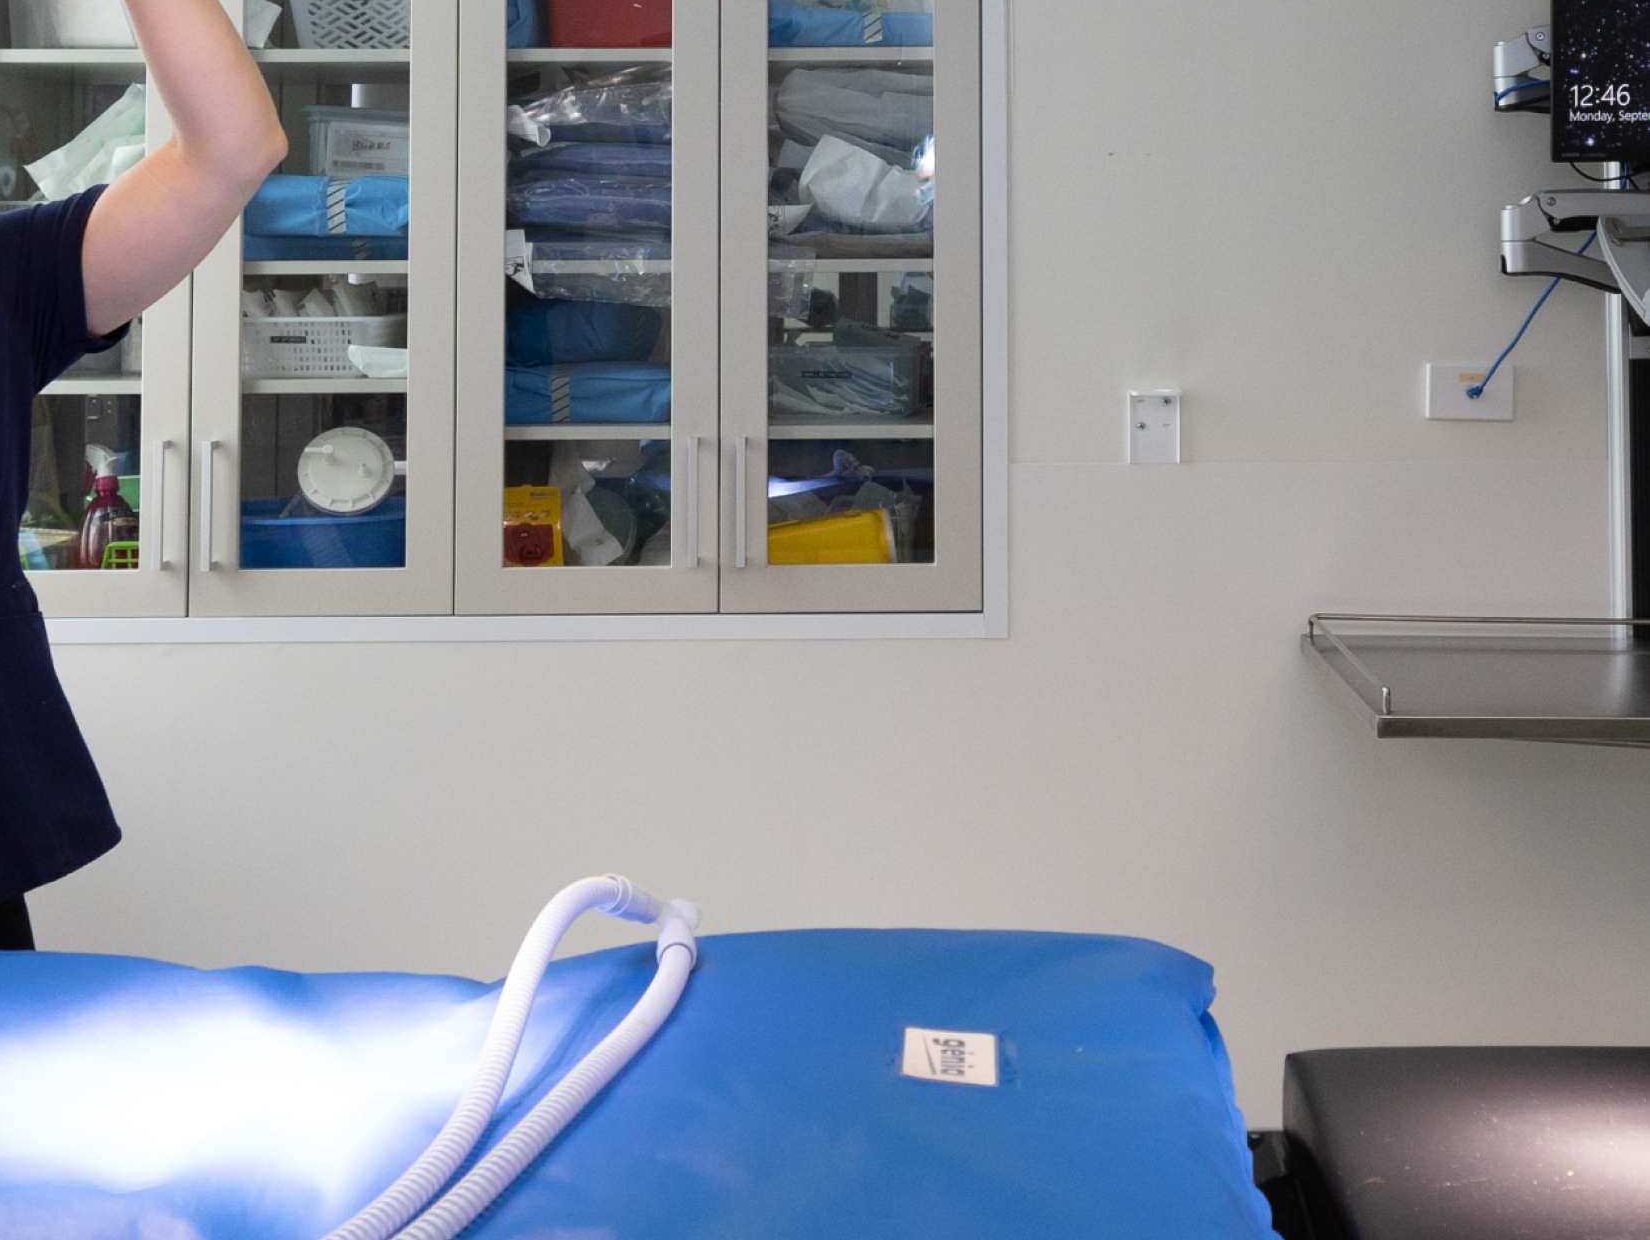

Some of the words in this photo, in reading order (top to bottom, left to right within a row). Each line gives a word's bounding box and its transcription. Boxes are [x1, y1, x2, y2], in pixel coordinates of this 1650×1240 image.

[1569, 83, 1631, 108] 12:46
[1569, 110, 1616, 124] Monday,
[1618, 110, 1650, 124] Septe
